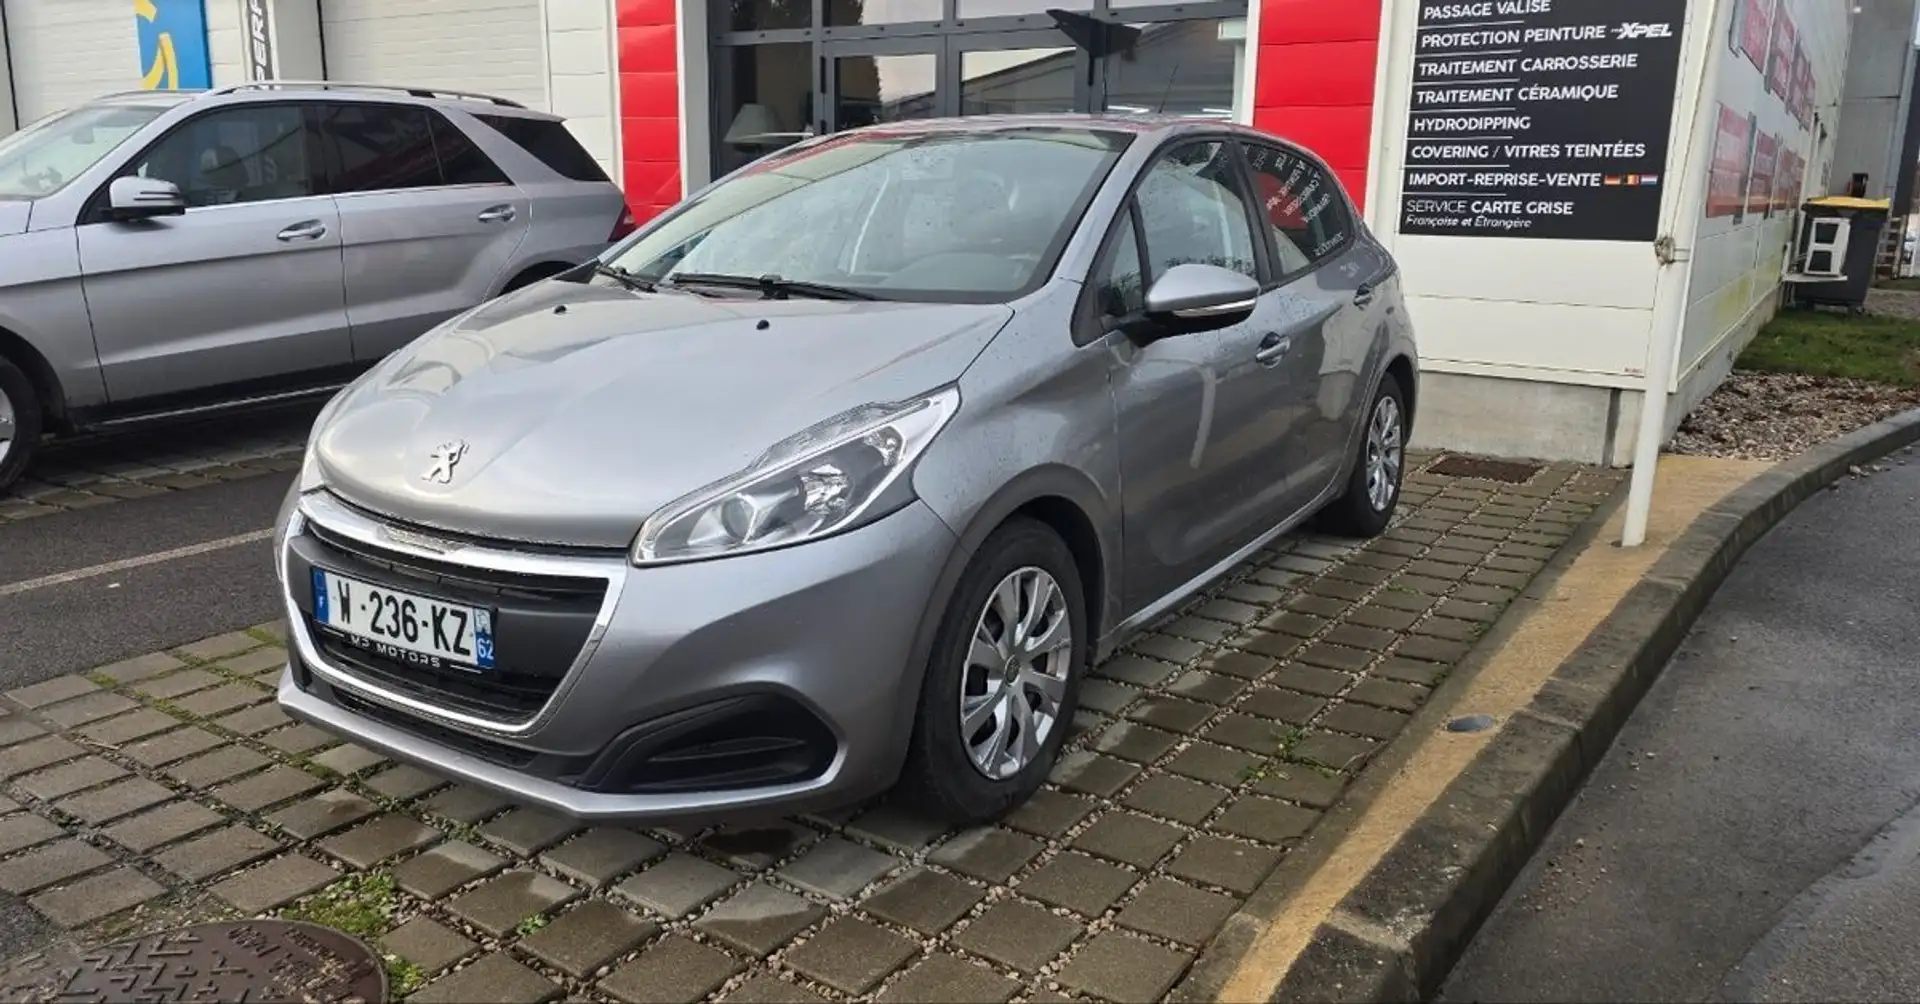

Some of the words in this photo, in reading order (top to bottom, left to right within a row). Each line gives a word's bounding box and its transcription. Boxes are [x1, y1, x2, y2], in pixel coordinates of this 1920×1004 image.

[1424, 3, 1493, 19] PASSAGE
[1496, 0, 1551, 14] VALISE
[1421, 30, 1520, 48] PROTECTION
[1524, 25, 1606, 43] PEINTURE
[1615, 22, 1673, 39] XPEL
[1419, 59, 1517, 76] TRAITEMENT
[1521, 53, 1638, 72] CARROSSERIE
[1417, 87, 1514, 104] TRAITEMENT
[1518, 84, 1619, 101] CÉRAMIQUE
[1414, 116, 1531, 131] HYDRODIPPING
[1411, 144, 1489, 158] COVERING
[1504, 143, 1560, 158] VITRES
[1565, 140, 1646, 158] TEINTÉES
[1409, 172, 1602, 187] IMPORT-REPRISE-VENTE
[1406, 200, 1467, 214] SERVICE
[1471, 201, 1522, 214] CARTE
[1526, 202, 1575, 215] GRISE
[1405, 215, 1458, 228] Française
[1461, 217, 1473, 227] et
[1474, 215, 1533, 230] Étrangère
[376, 642, 441, 668] MOTORS
[476, 637, 495, 661] 62
